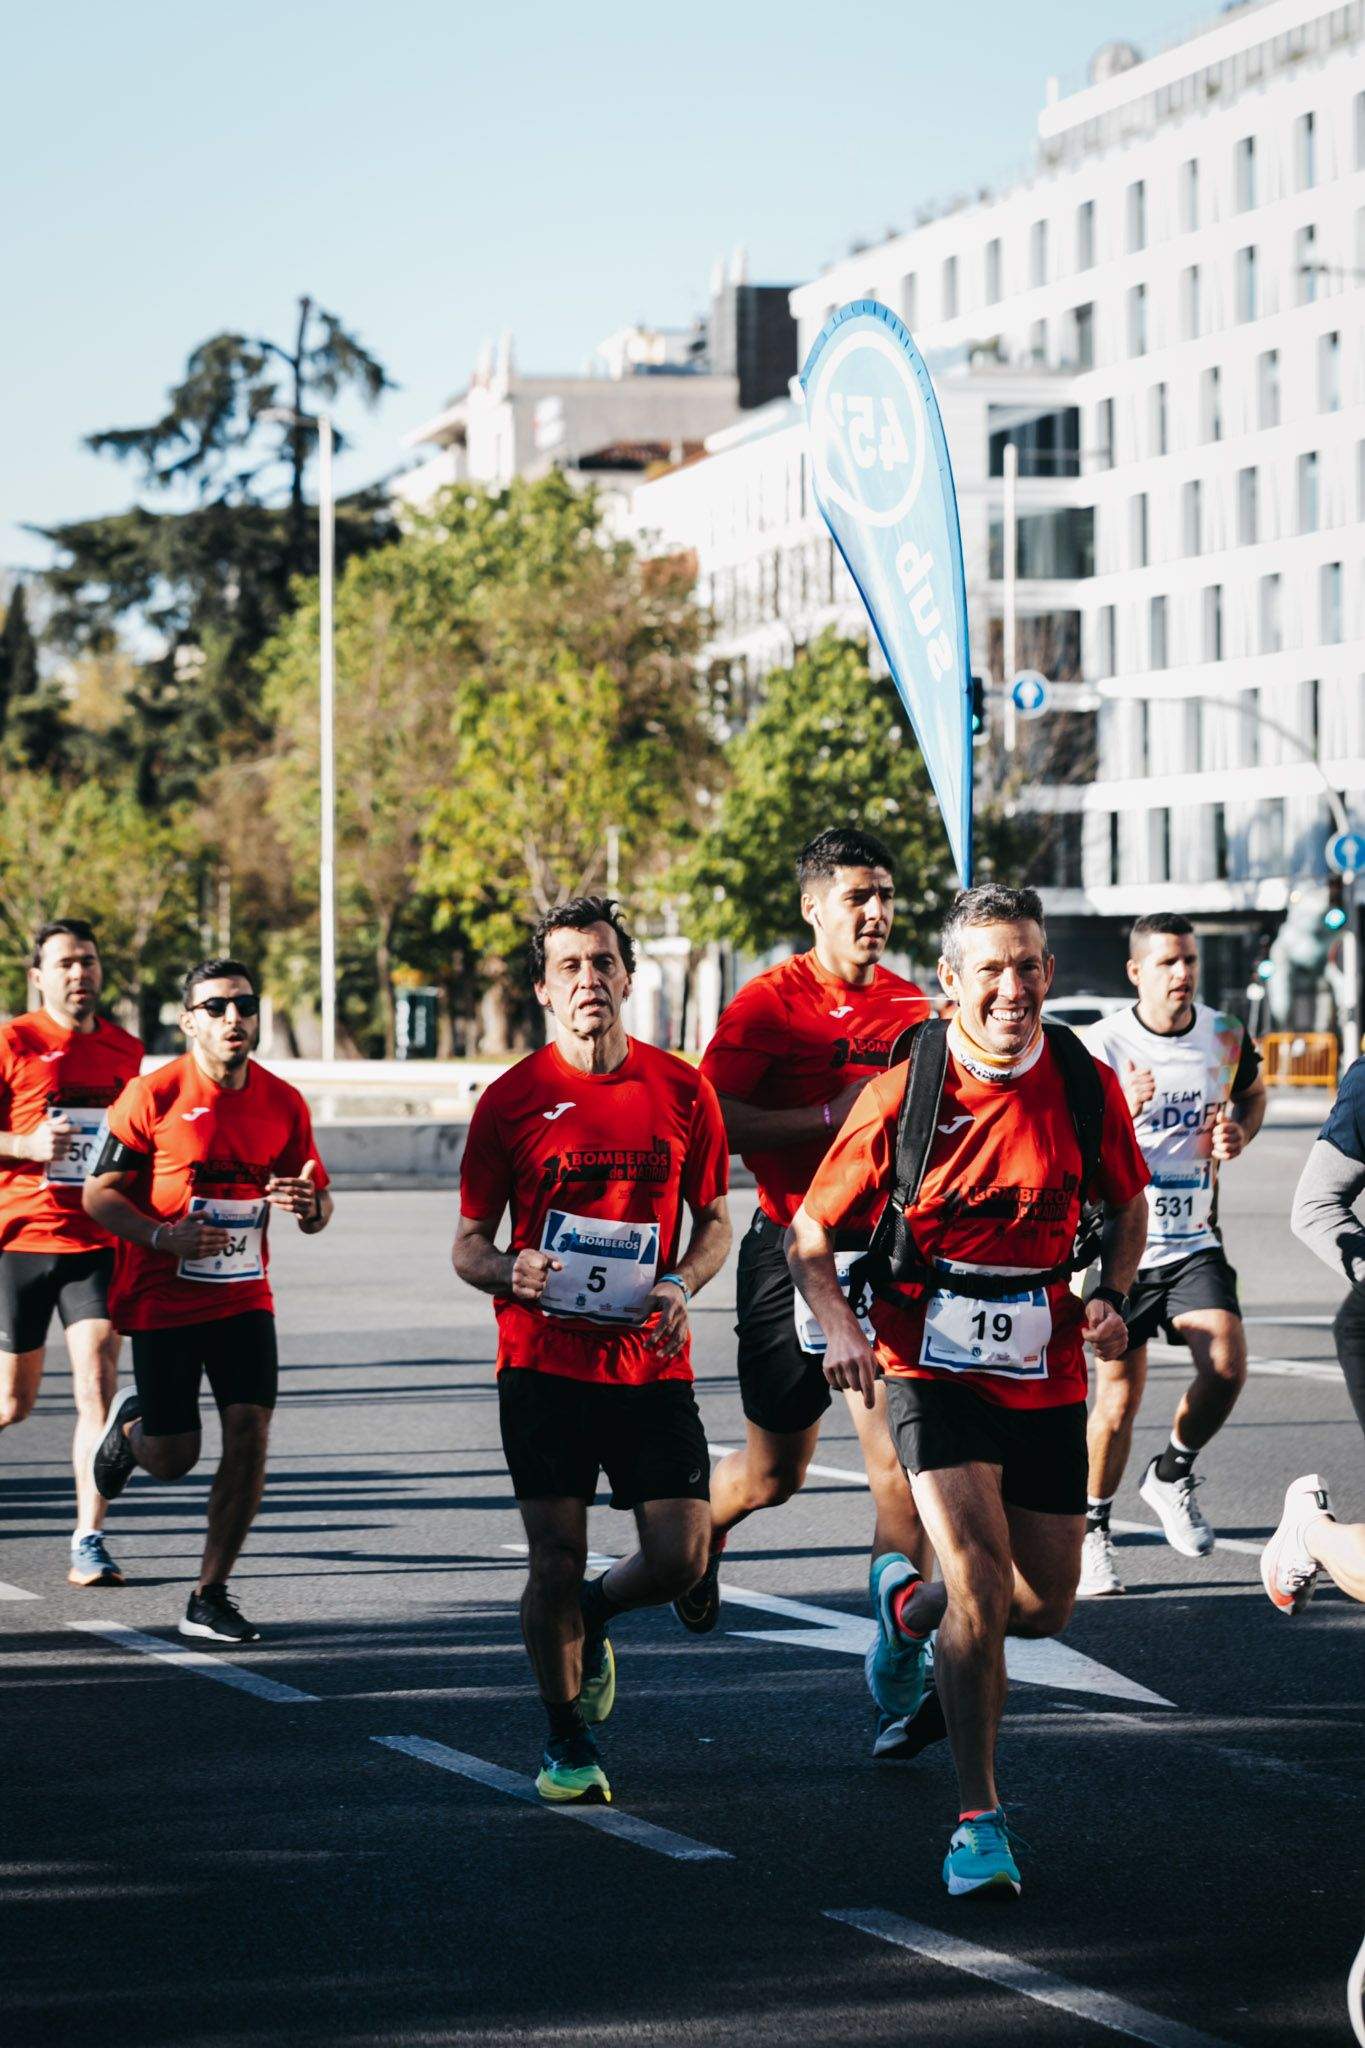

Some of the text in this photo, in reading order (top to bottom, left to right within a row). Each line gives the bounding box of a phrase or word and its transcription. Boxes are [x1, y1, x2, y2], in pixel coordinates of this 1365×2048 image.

[1161, 1090, 1202, 1104] TEAM
[571, 1151, 669, 1167] BOMBEROS
[1155, 1195, 1193, 1218] 531
[579, 1233, 640, 1251] BOMBEROS
[586, 1265, 607, 1293] 5
[971, 1310, 1013, 1342] 19
